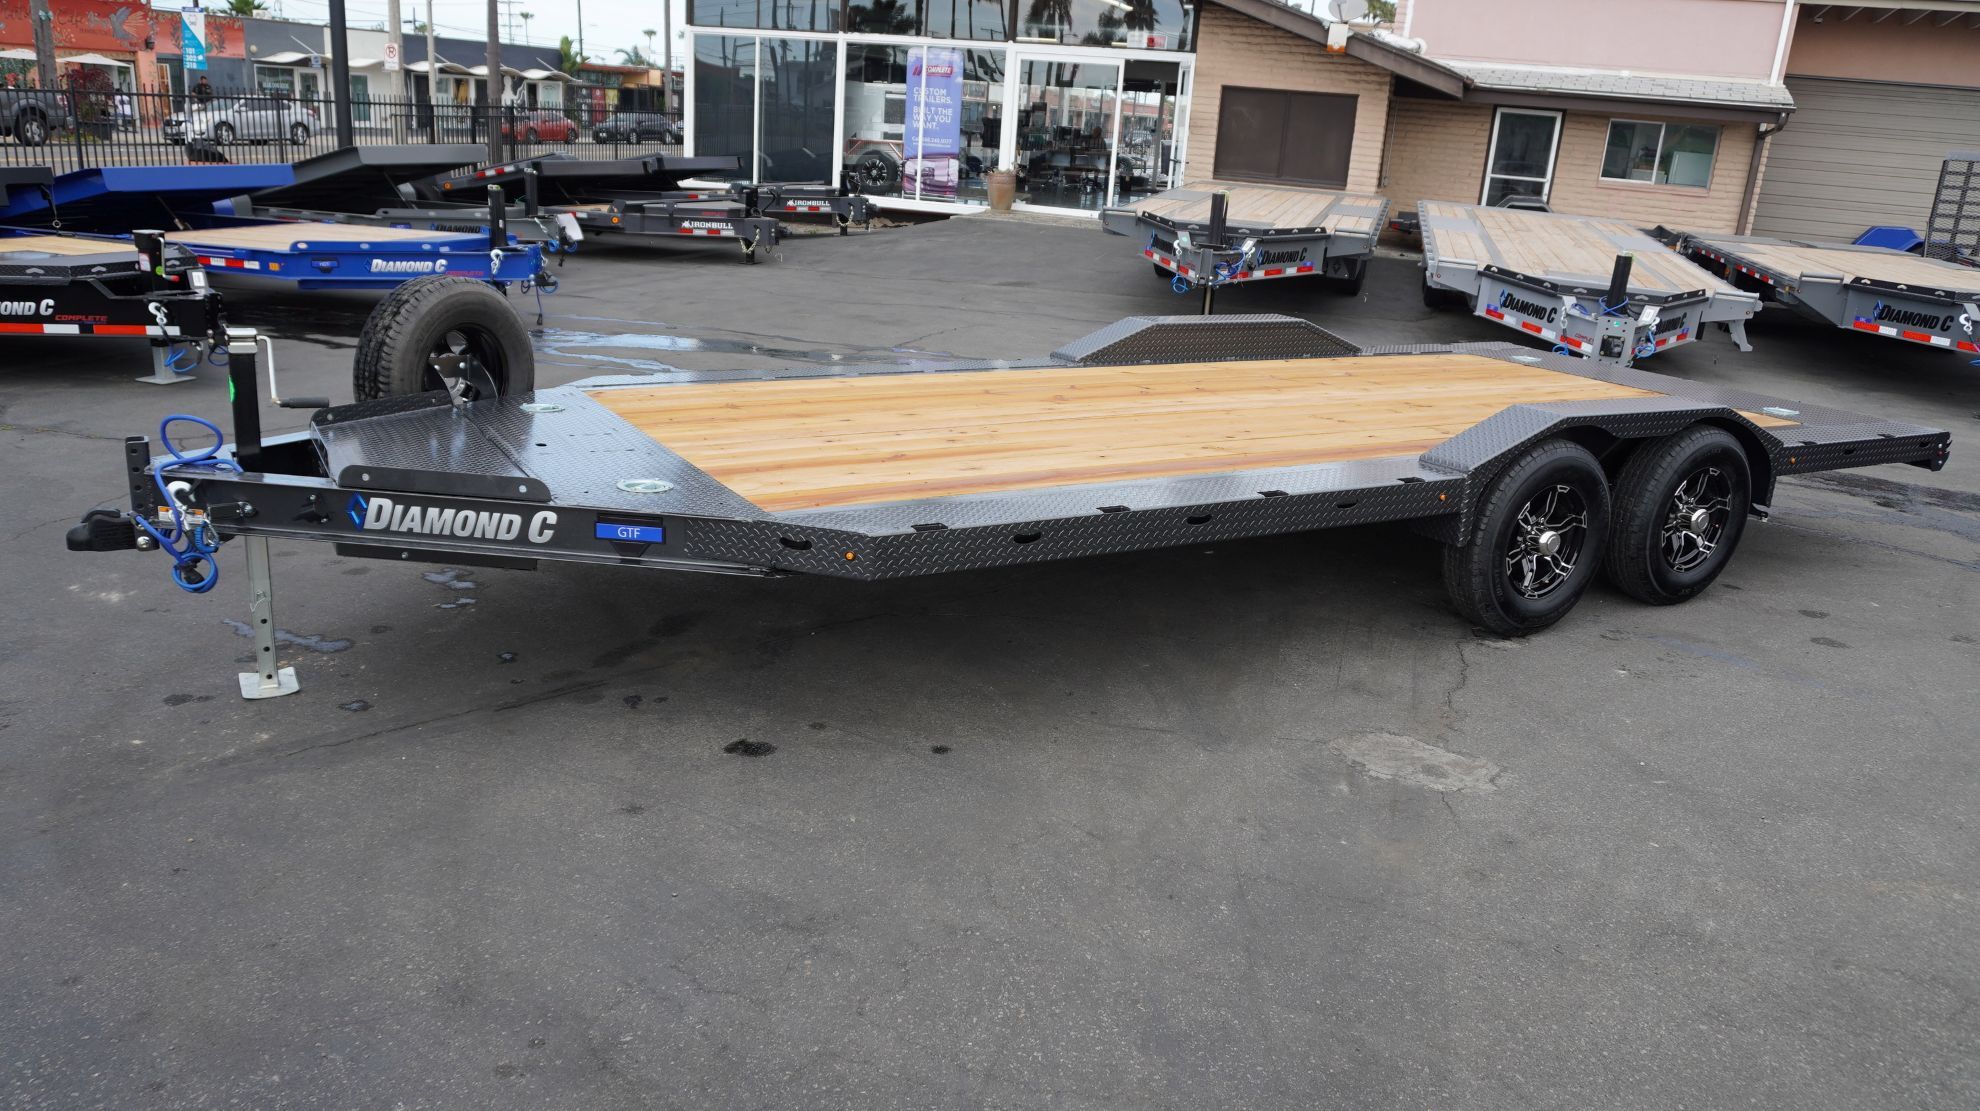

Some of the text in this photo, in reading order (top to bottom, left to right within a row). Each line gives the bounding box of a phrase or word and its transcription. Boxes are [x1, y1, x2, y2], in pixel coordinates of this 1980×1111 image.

[925, 66, 951, 74] OMPLETE
[913, 106, 953, 116] BLT THE
[934, 115, 951, 123] YOU
[690, 221, 734, 229] IRONBULL
[1262, 247, 1308, 265] DIAMOND C
[370, 258, 448, 273] DIAMOND C
[0, 299, 55, 316] OND C
[1504, 292, 1558, 324] DIAMOND C
[1879, 304, 1955, 332] DIAMOND C
[364, 496, 558, 544] DIAMOND C
[616, 526, 641, 540] GTF
